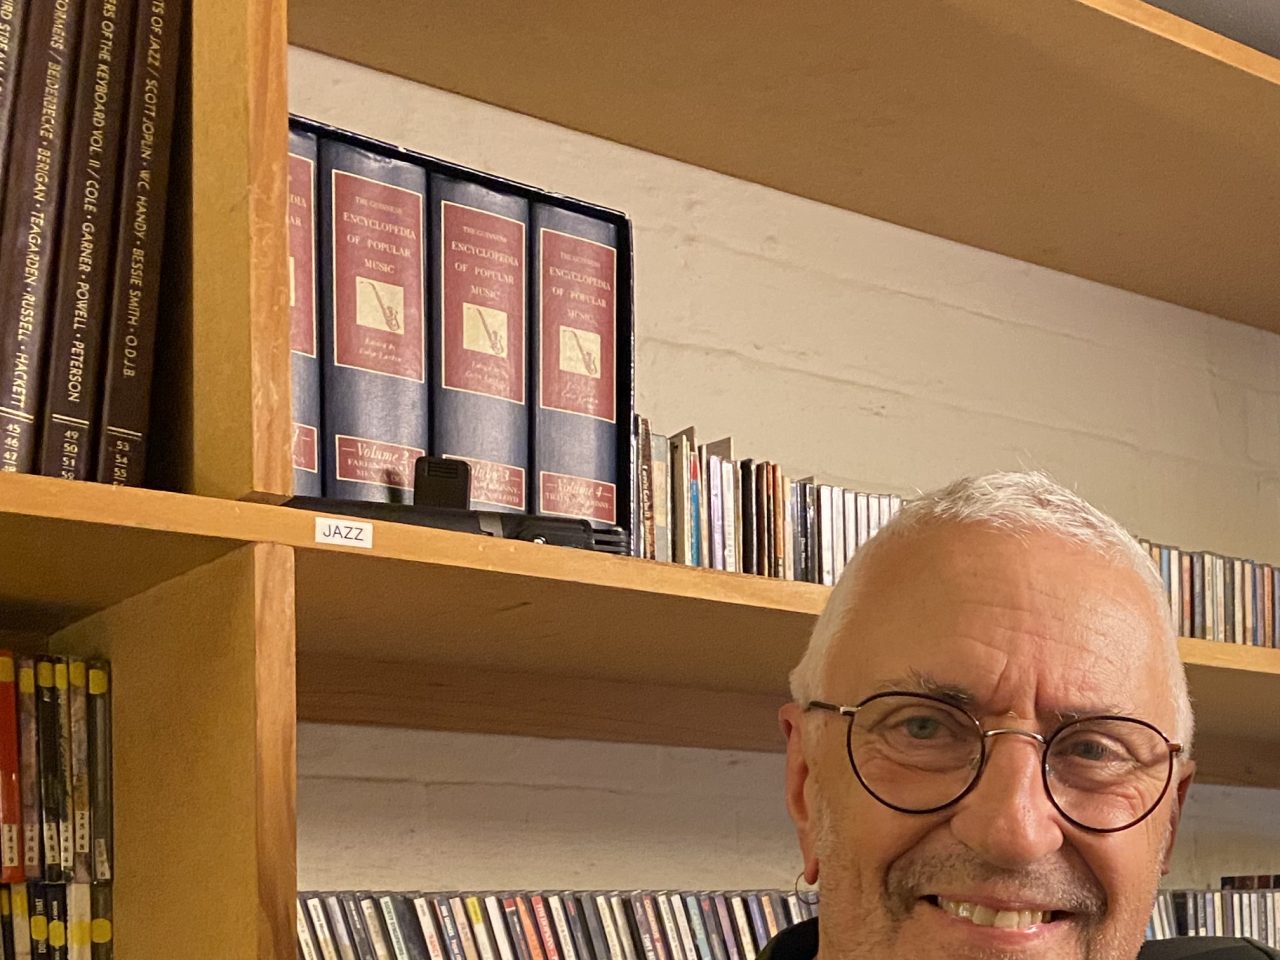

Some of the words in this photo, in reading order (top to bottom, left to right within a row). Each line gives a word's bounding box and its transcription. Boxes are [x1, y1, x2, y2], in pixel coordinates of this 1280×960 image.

[100, 20, 114, 40] OF
[151, 16, 163, 34] OF
[99, 39, 112, 60] THE
[147, 35, 161, 66] JAZZ
[40, 62, 61, 139] BEIDERBECKE
[92, 64, 110, 127] KEYBOARD
[144, 79, 158, 117] SCOTT
[140, 117, 155, 159] JOPLIN
[33, 148, 51, 201] BERIGAN
[84, 180, 99, 211] COLE
[133, 196, 148, 238] HANDY
[343, 212, 416, 239] ENCYCLOPEDIA
[24, 211, 44, 284] TEAGARDEN
[78, 222, 95, 272] GARNER
[347, 235, 360, 244] OF
[368, 240, 411, 257] POPULAR
[452, 241, 519, 267] ENCYCLOPEDIA
[130, 248, 144, 285] BESSIE
[365, 259, 395, 273] MUSIC
[455, 262, 468, 272] OF
[475, 267, 514, 284] POPULAR
[550, 267, 611, 291] ENCYCLOPEDIA
[553, 287, 564, 296] OF
[17, 293, 35, 342] RUSSELL
[73, 281, 90, 330] POWELL
[127, 289, 141, 325] SMITH
[10, 352, 28, 408] HACKETT
[67, 340, 84, 402] PETERSON
[6, 424, 21, 433] 45
[64, 431, 79, 439] 49
[4, 437, 19, 447] 46
[63, 443, 78, 453] 50
[116, 441, 129, 451] 53
[358, 443, 399, 461] Volume
[62, 457, 75, 467] 51
[115, 454, 128, 464] 54
[114, 468, 127, 477] 55
[323, 525, 364, 542] JAZZ
